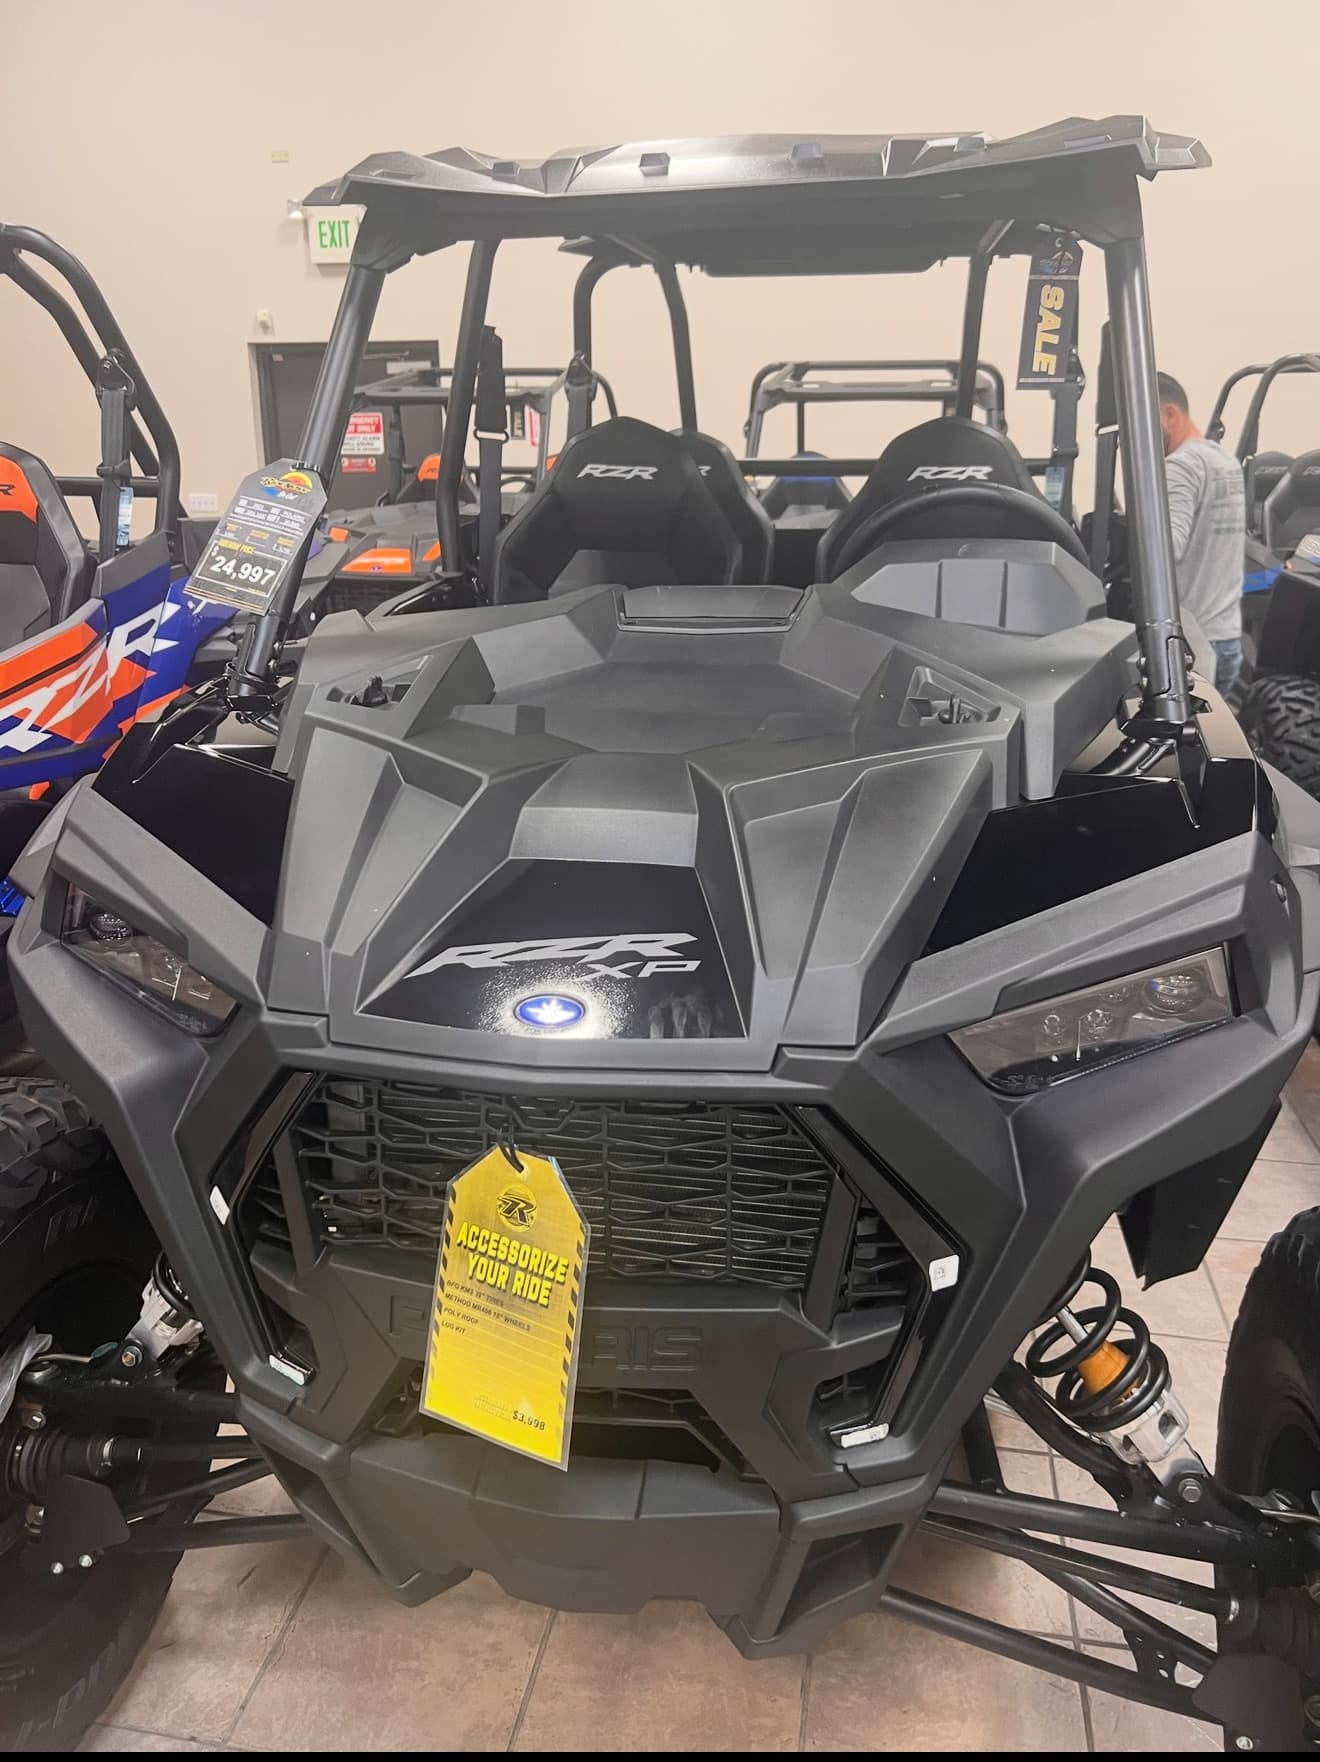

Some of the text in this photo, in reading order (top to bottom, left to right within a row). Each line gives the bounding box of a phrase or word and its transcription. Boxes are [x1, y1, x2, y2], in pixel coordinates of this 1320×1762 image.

[318, 220, 350, 248] EXIT
[1032, 284, 1065, 375] SALE
[577, 464, 658, 480] RZR
[906, 466, 993, 481] RZR
[404, 933, 698, 979] RZR
[578, 960, 702, 982] XP
[456, 1221, 569, 1285] ACCESSORIZE
[467, 1251, 554, 1308] YOUR RIDE
[443, 1306, 460, 1318] POLY
[445, 1292, 472, 1308] METHOD
[504, 1315, 531, 1332] WHEELS
[440, 1319, 467, 1335] LUG KIT
